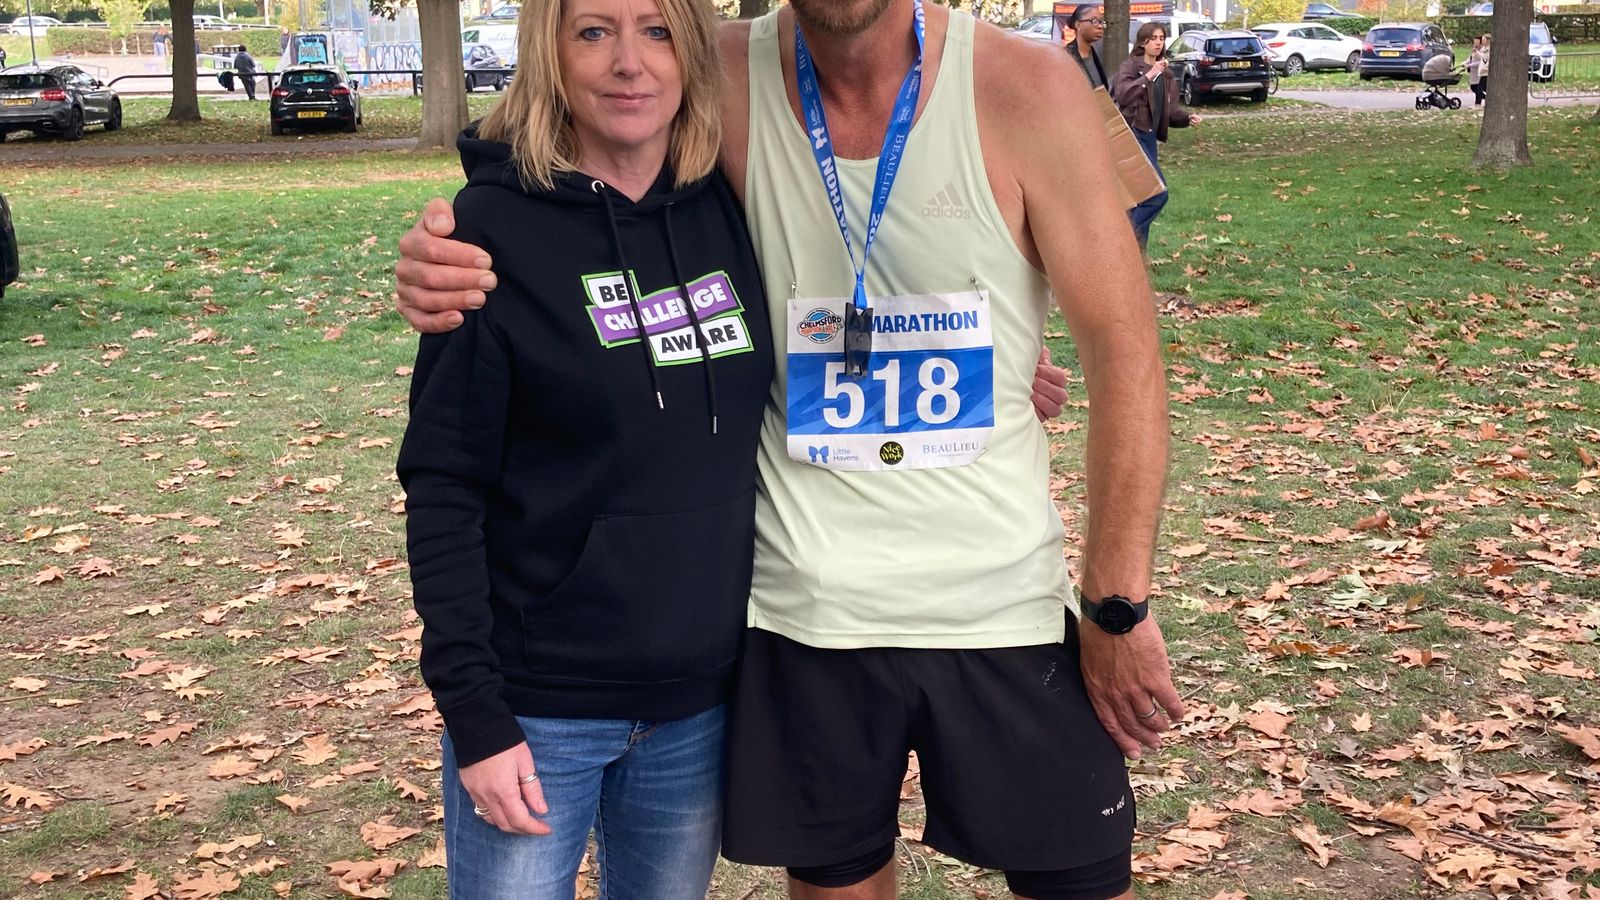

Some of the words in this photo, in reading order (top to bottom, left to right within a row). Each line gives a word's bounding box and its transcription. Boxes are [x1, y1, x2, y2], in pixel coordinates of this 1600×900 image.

[921, 206, 972, 220] adidas
[598, 283, 629, 303] BE
[799, 315, 842, 330] CHELMSFORD
[822, 357, 961, 429] 518
[832, 447, 852, 455] Little
[883, 444, 901, 455] Nice
[922, 441, 980, 455] BEAULIEU
[832, 454, 859, 462] Havens
[880, 450, 903, 462] Work
